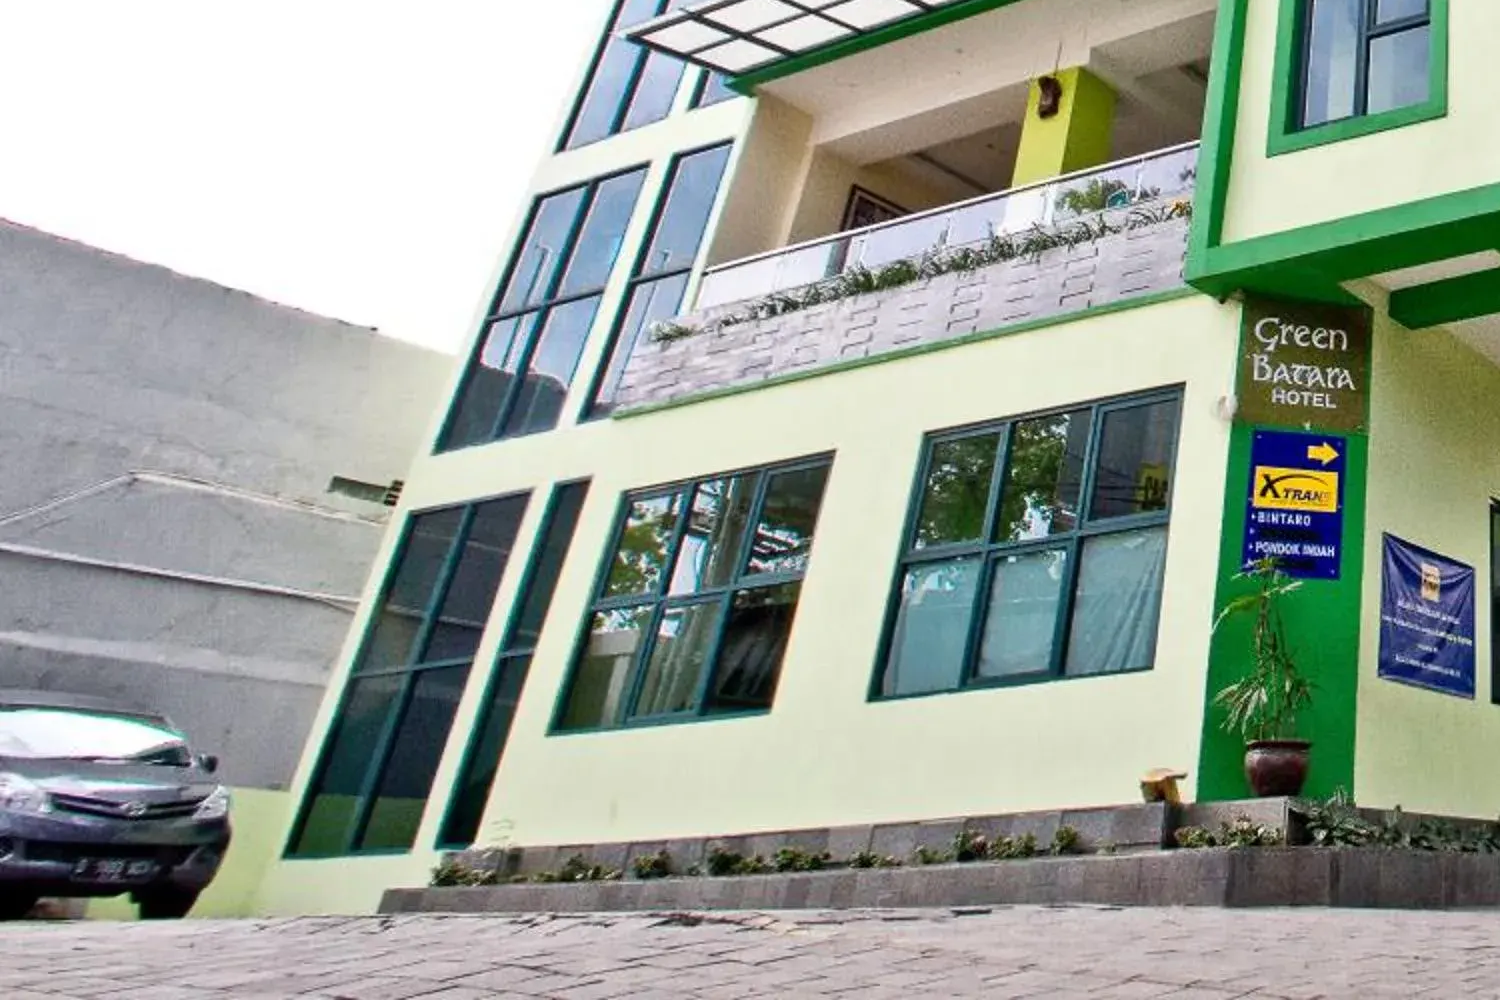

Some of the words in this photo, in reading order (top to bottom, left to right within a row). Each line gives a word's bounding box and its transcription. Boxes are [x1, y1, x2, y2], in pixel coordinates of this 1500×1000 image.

[1255, 317, 1348, 351] Green
[1271, 387, 1337, 408] HOTEL
[1257, 511, 1311, 526] BINTARO
[1255, 541, 1300, 555] PONDOK
